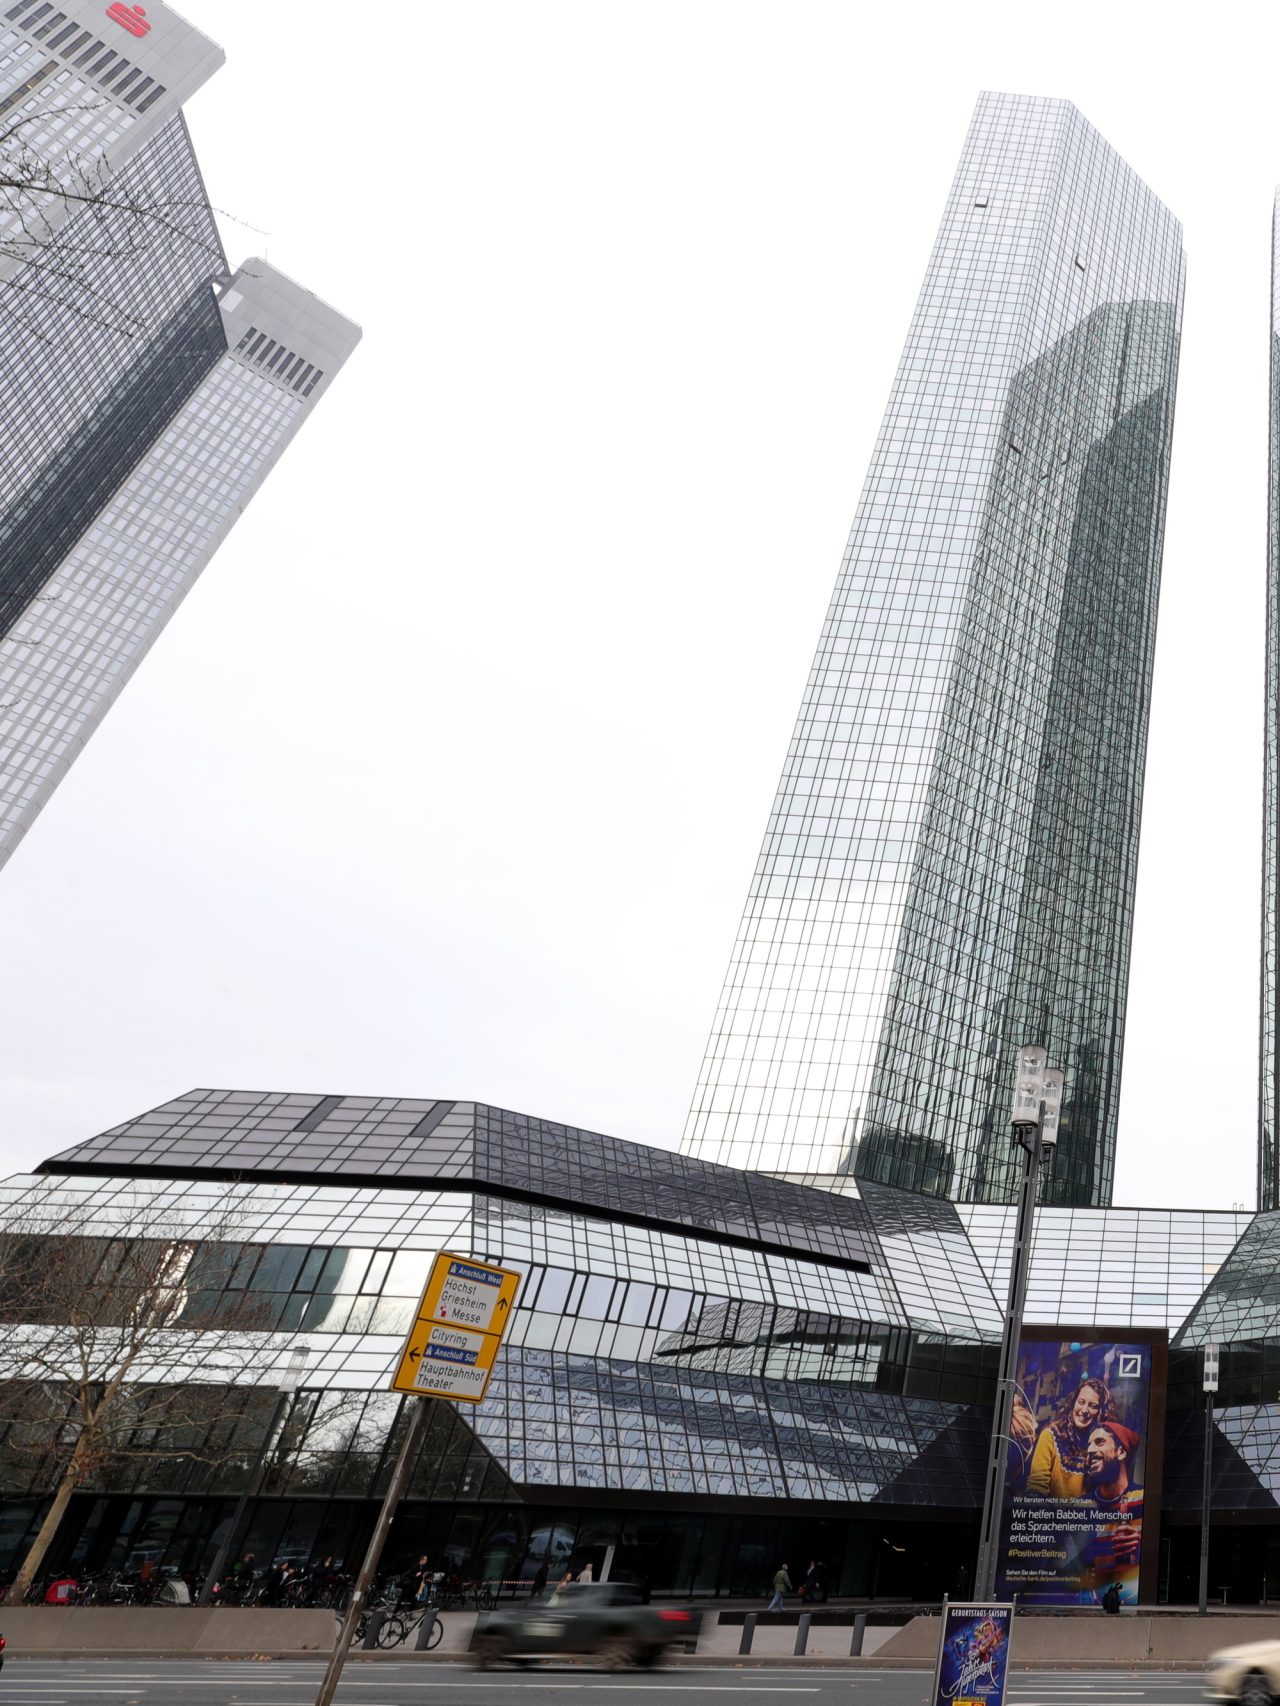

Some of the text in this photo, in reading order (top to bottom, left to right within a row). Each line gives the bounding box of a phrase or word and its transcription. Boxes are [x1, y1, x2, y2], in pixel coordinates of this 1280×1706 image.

[459, 1266, 487, 1281] Anschluß
[444, 1278, 476, 1295] Höchst
[441, 1290, 487, 1311] Griesheim
[451, 1308, 481, 1324] Messe
[431, 1328, 468, 1348] Cityring
[434, 1348, 464, 1361] Anschluß
[420, 1361, 485, 1382] Hauptbahnhof
[417, 1373, 454, 1390] Theater
[1012, 1509, 1133, 1520] Wir helfen Babbel, Menschen
[1010, 1520, 1105, 1533] das Sprachenlernen zu
[1009, 1532, 1057, 1543] erleichtern.
[1008, 1549, 1067, 1560] #PositiverBeitrag
